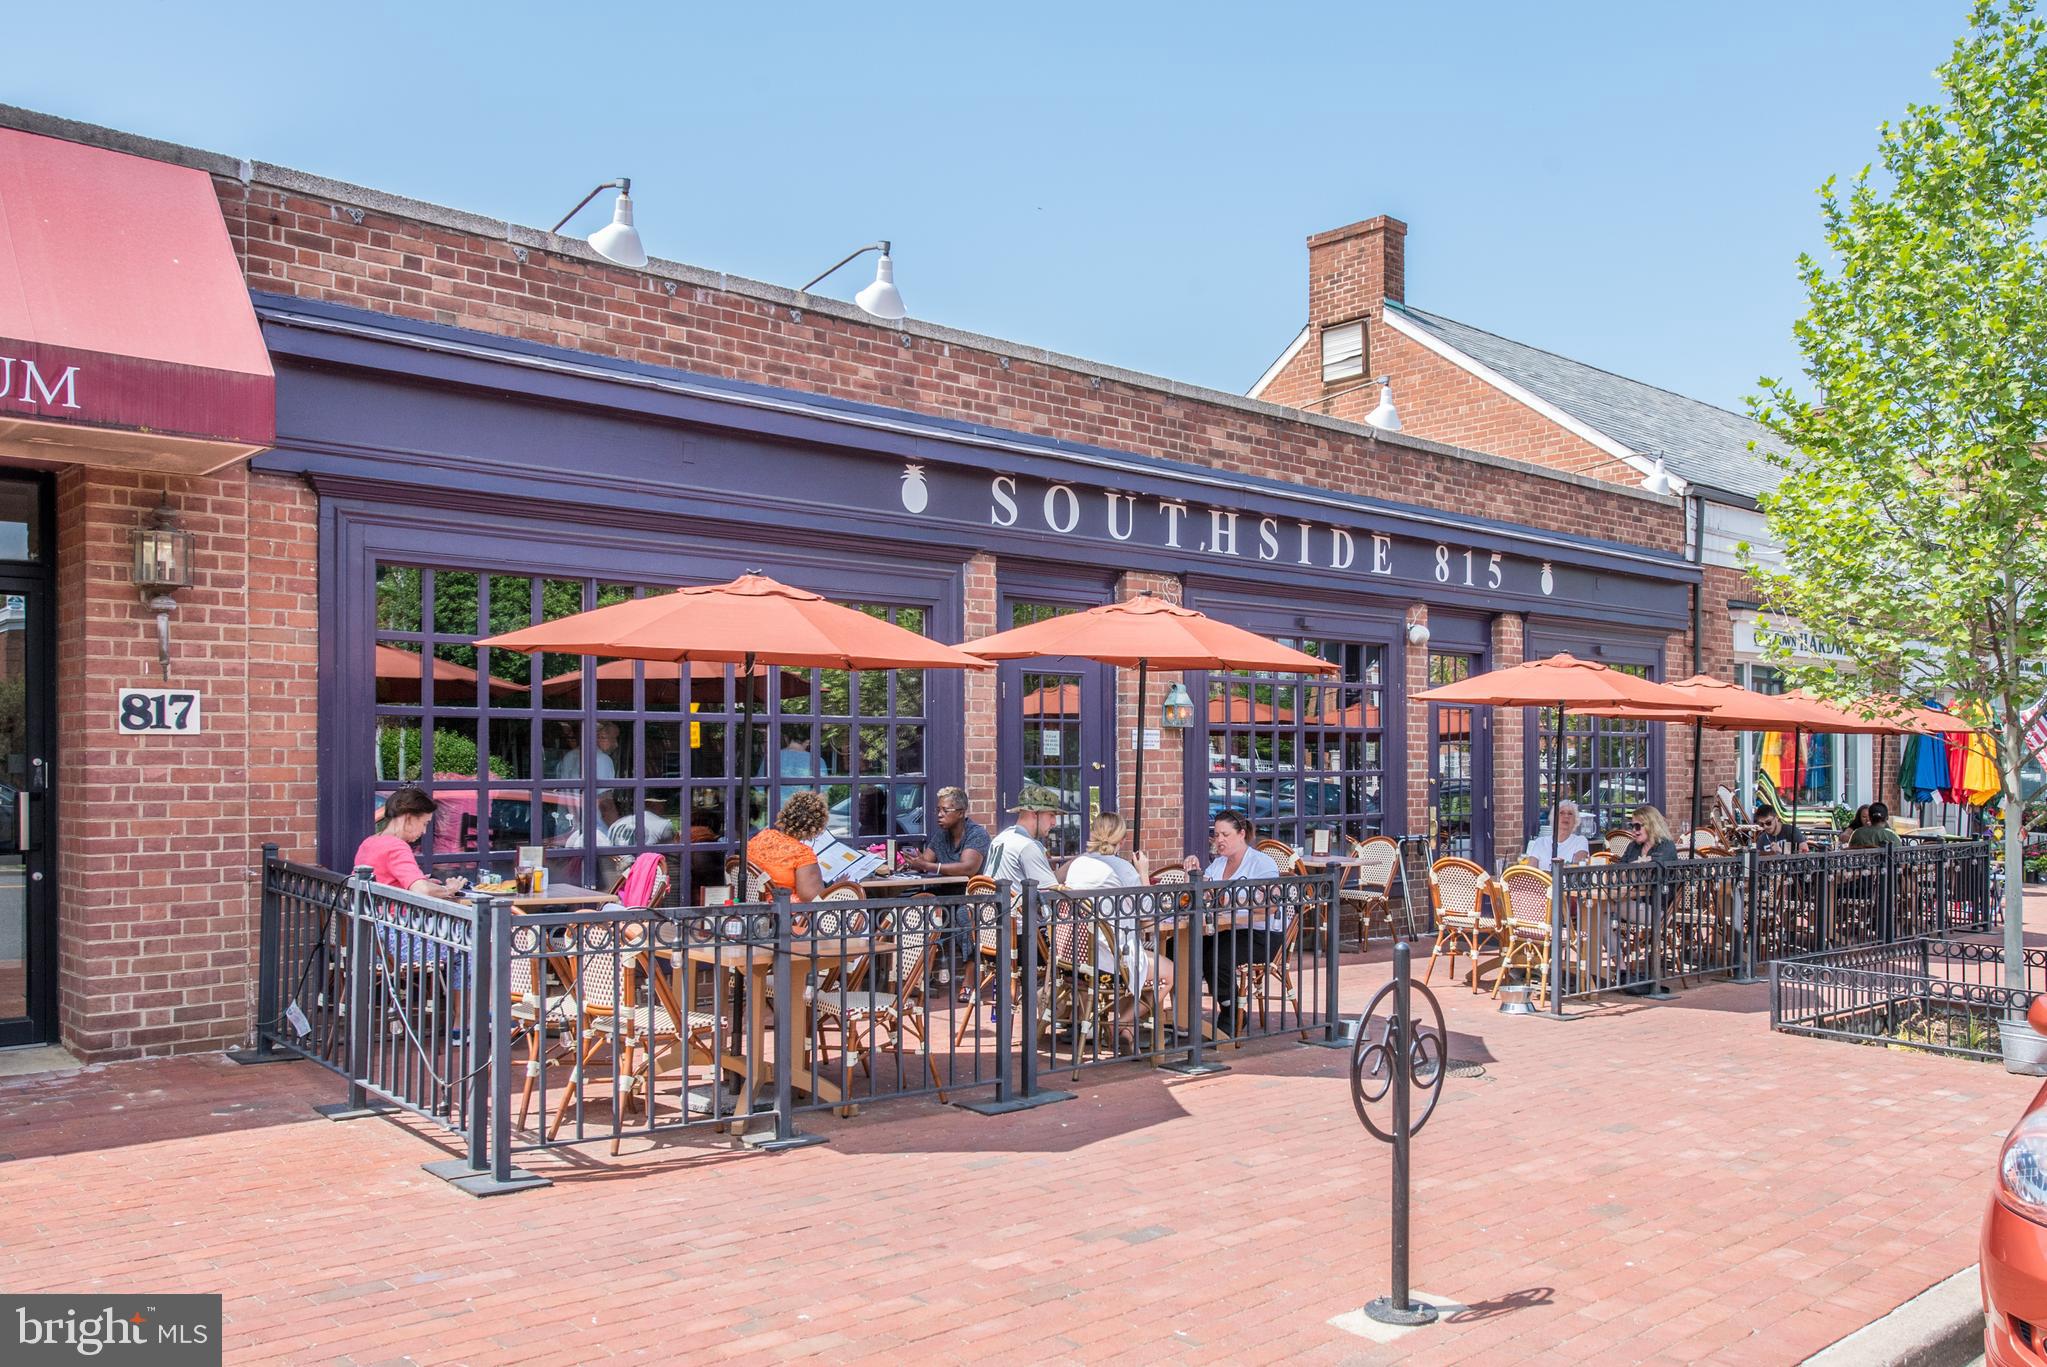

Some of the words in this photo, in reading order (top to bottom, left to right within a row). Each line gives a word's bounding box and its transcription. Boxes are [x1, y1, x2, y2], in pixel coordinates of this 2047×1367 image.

[992, 477, 1393, 575] SOUTHSIDE
[1435, 545, 1503, 589] 815
[121, 693, 195, 730] 817
